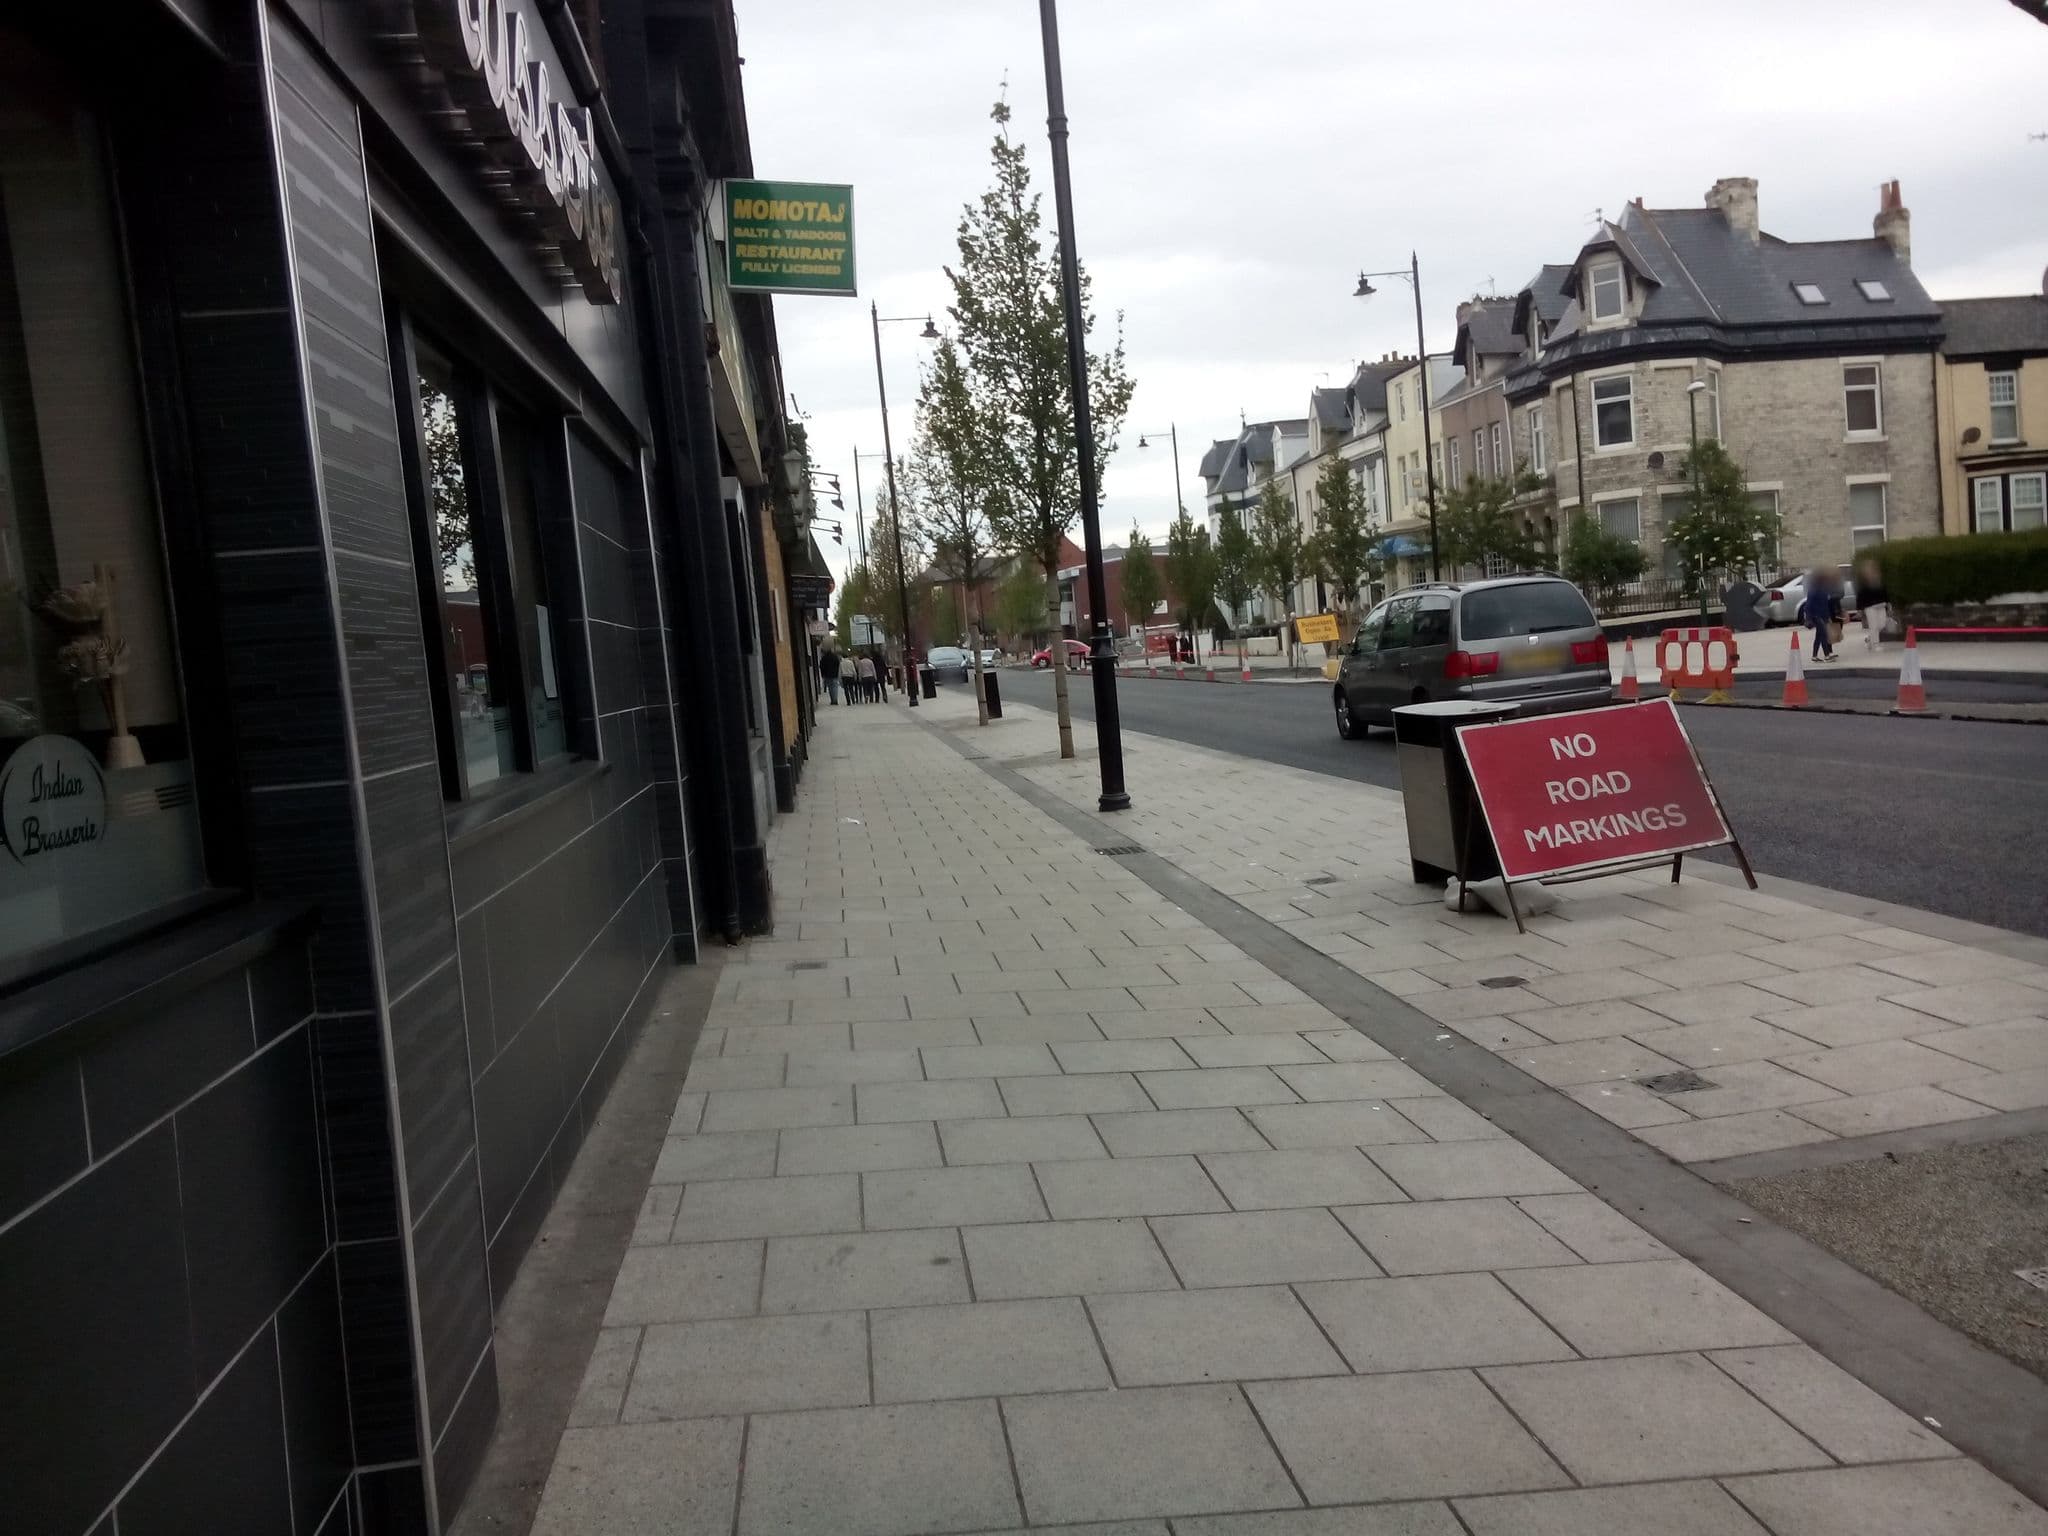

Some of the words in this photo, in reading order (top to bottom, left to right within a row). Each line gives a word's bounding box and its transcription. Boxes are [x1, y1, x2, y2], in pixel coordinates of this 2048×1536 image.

[734, 199, 846, 223] MOMOTAJ
[736, 245, 846, 261] RESTAURANT
[741, 262, 779, 273] FULLY
[1550, 733, 1597, 760] NO
[30, 760, 84, 803] Indian
[1545, 770, 1631, 805] ROAD
[22, 816, 97, 857] Brasserie
[1524, 803, 1687, 852] MARKINGS
